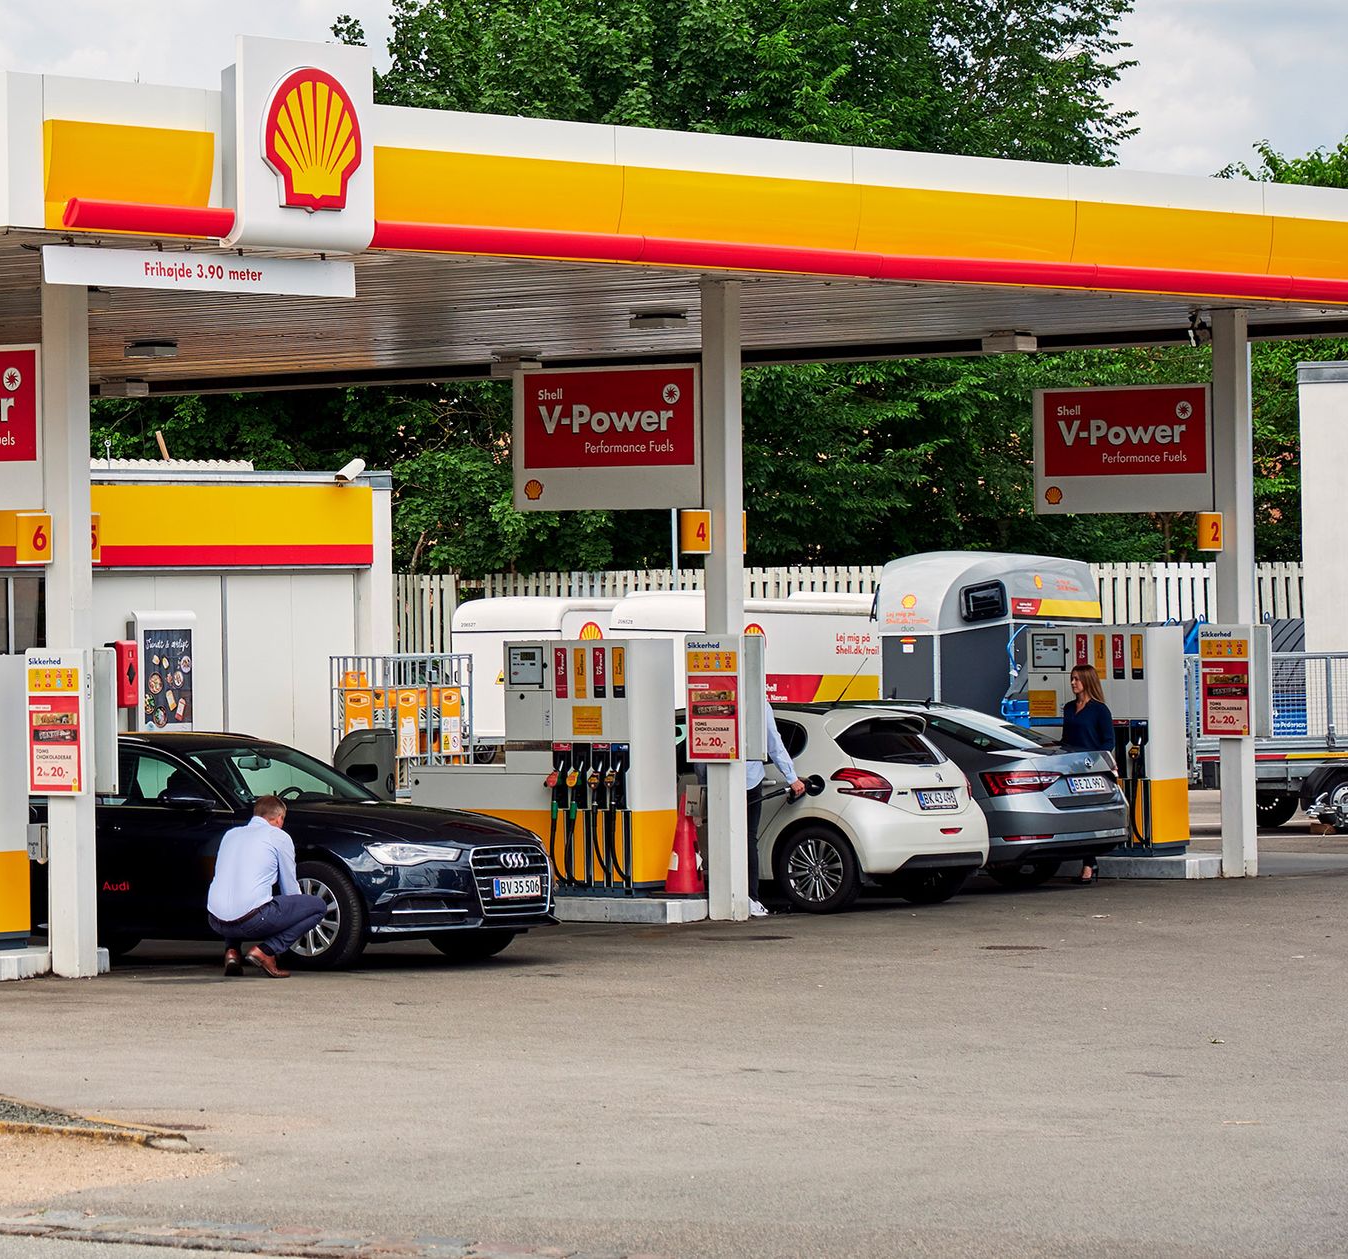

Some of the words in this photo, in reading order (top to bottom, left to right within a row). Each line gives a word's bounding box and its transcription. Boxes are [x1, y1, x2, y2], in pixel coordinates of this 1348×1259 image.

[144, 262, 192, 281] Frihøjde
[196, 264, 223, 280] 3.90
[228, 269, 262, 281] meter
[538, 389, 563, 400] Shell
[1057, 405, 1081, 416] Shell
[538, 404, 674, 434] V-Power
[1057, 419, 1187, 446] V-Power
[585, 441, 646, 454] Performance
[649, 440, 674, 452] Fuels
[1102, 452, 1160, 464] Performance
[1163, 450, 1187, 462] Fuels
[32, 525, 47, 551] 6
[696, 522, 706, 542] 4
[1211, 522, 1219, 542] 2
[836, 633, 845, 644] Lej
[847, 633, 859, 644] mig
[862, 633, 870, 644] på
[1223, 716, 1239, 725] 20,-
[695, 737, 701, 746] 2
[709, 737, 726, 748] 20,-
[37, 766, 43, 777] 2
[51, 766, 68, 779] 20,-
[923, 793, 935, 804] BK
[935, 792, 943, 804] 43
[102, 881, 130, 891] Audi
[500, 881, 512, 895] BV
[514, 880, 524, 894] 35
[525, 879, 540, 893] 506
